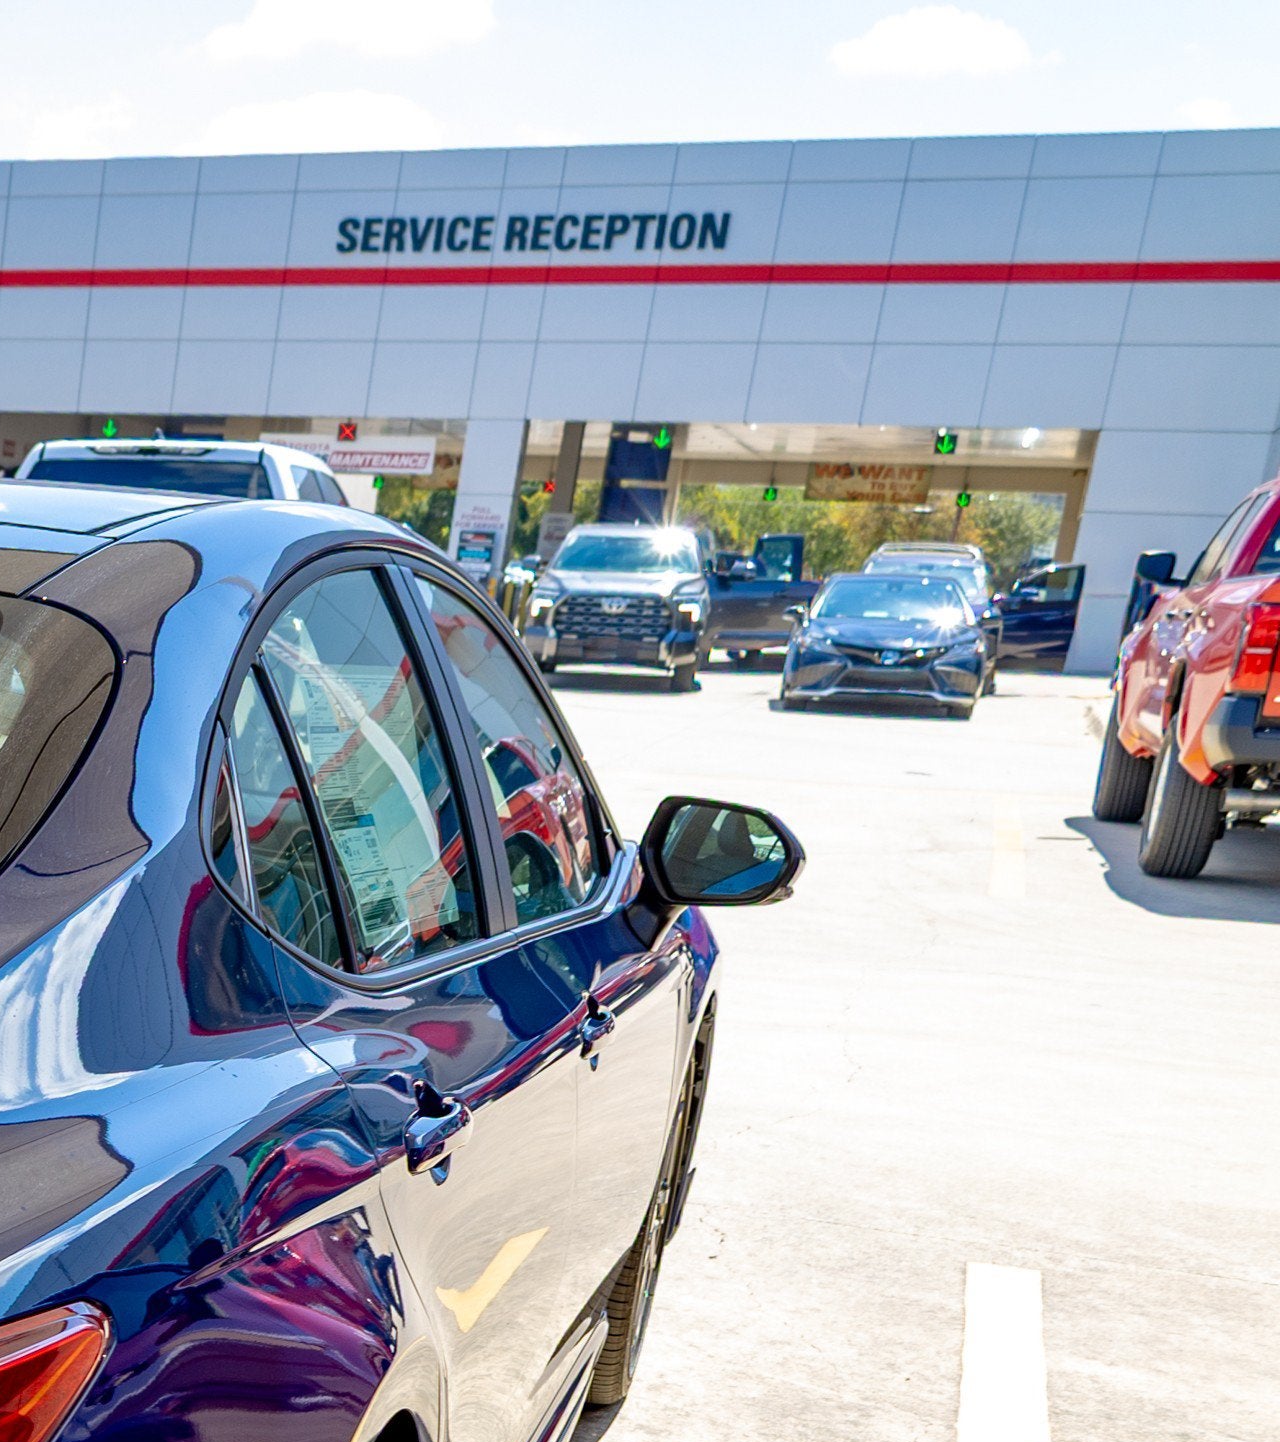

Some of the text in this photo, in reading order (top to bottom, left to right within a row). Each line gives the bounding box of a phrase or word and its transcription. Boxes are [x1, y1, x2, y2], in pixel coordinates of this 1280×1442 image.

[336, 212, 731, 254] SERVICE RECEPTION
[330, 454, 429, 468] MAINTENANCE
[860, 464, 928, 481] WANT
